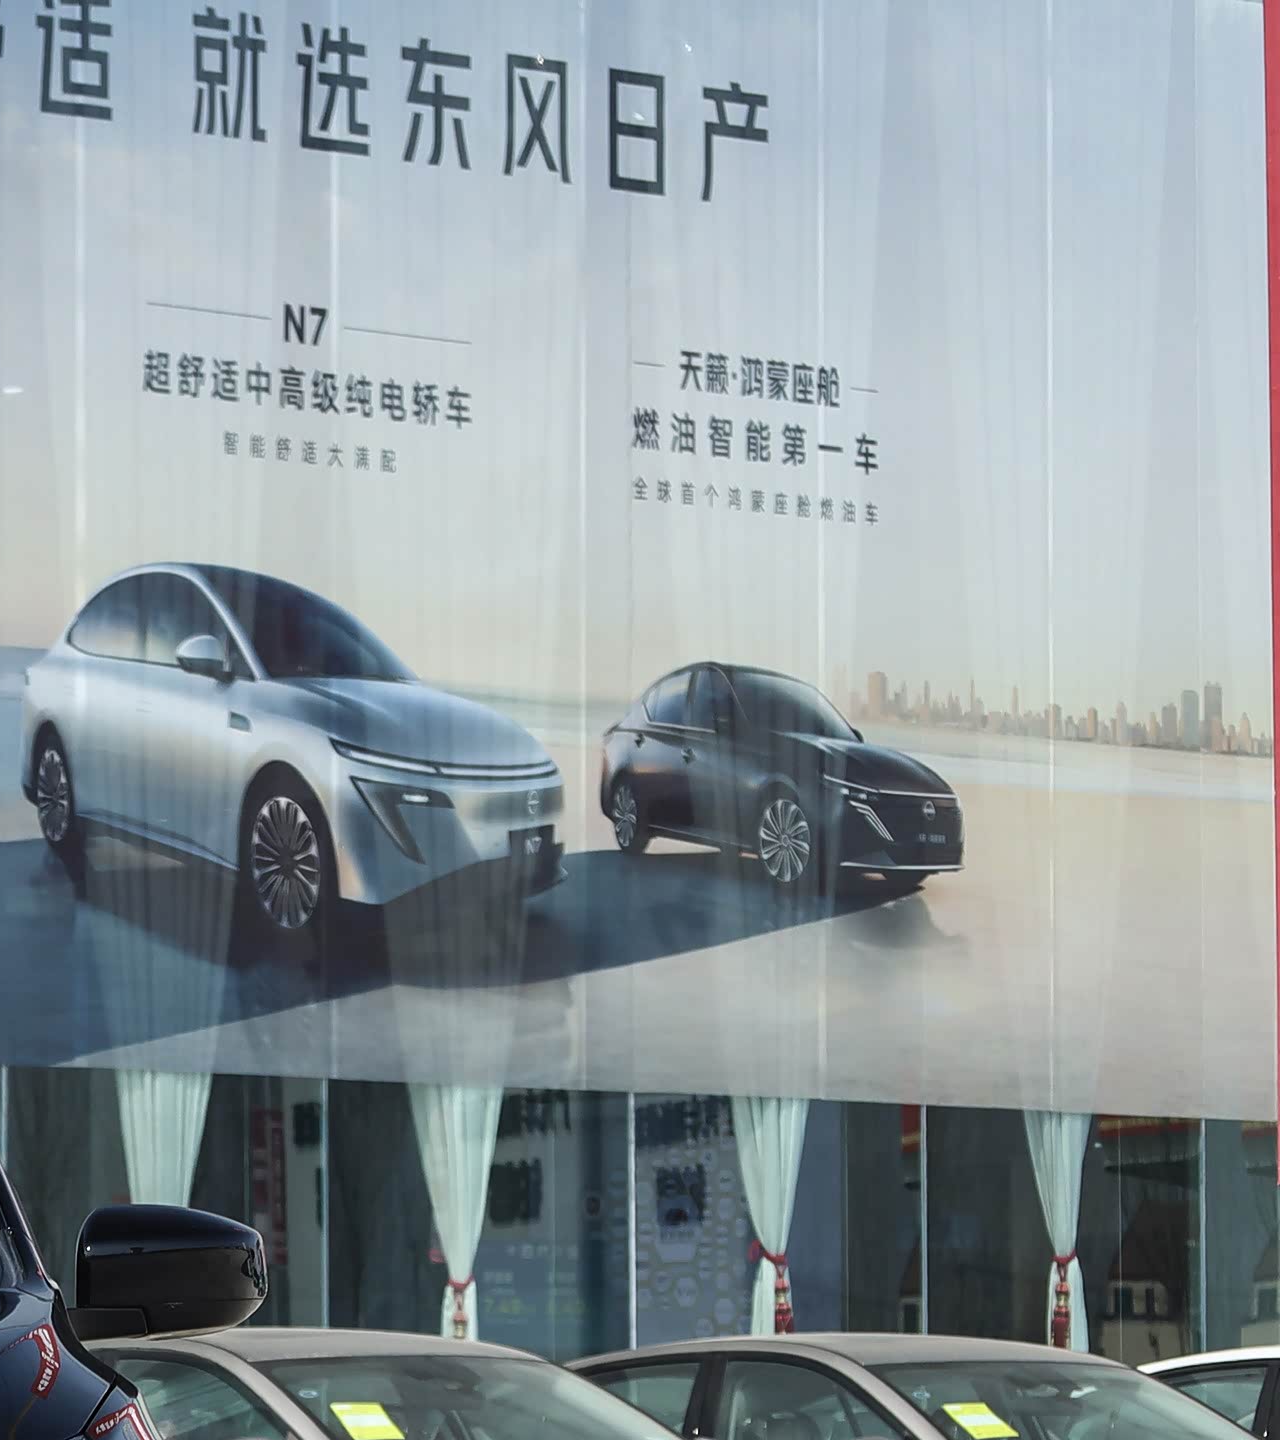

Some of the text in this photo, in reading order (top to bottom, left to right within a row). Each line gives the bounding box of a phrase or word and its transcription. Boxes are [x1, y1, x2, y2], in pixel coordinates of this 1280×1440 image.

[192, 5, 770, 202] 就选东风日产
[283, 302, 329, 346] N7
[142, 349, 474, 429] 超舒适中高级纯电轿车
[632, 406, 879, 476] 燃油智能第一车
